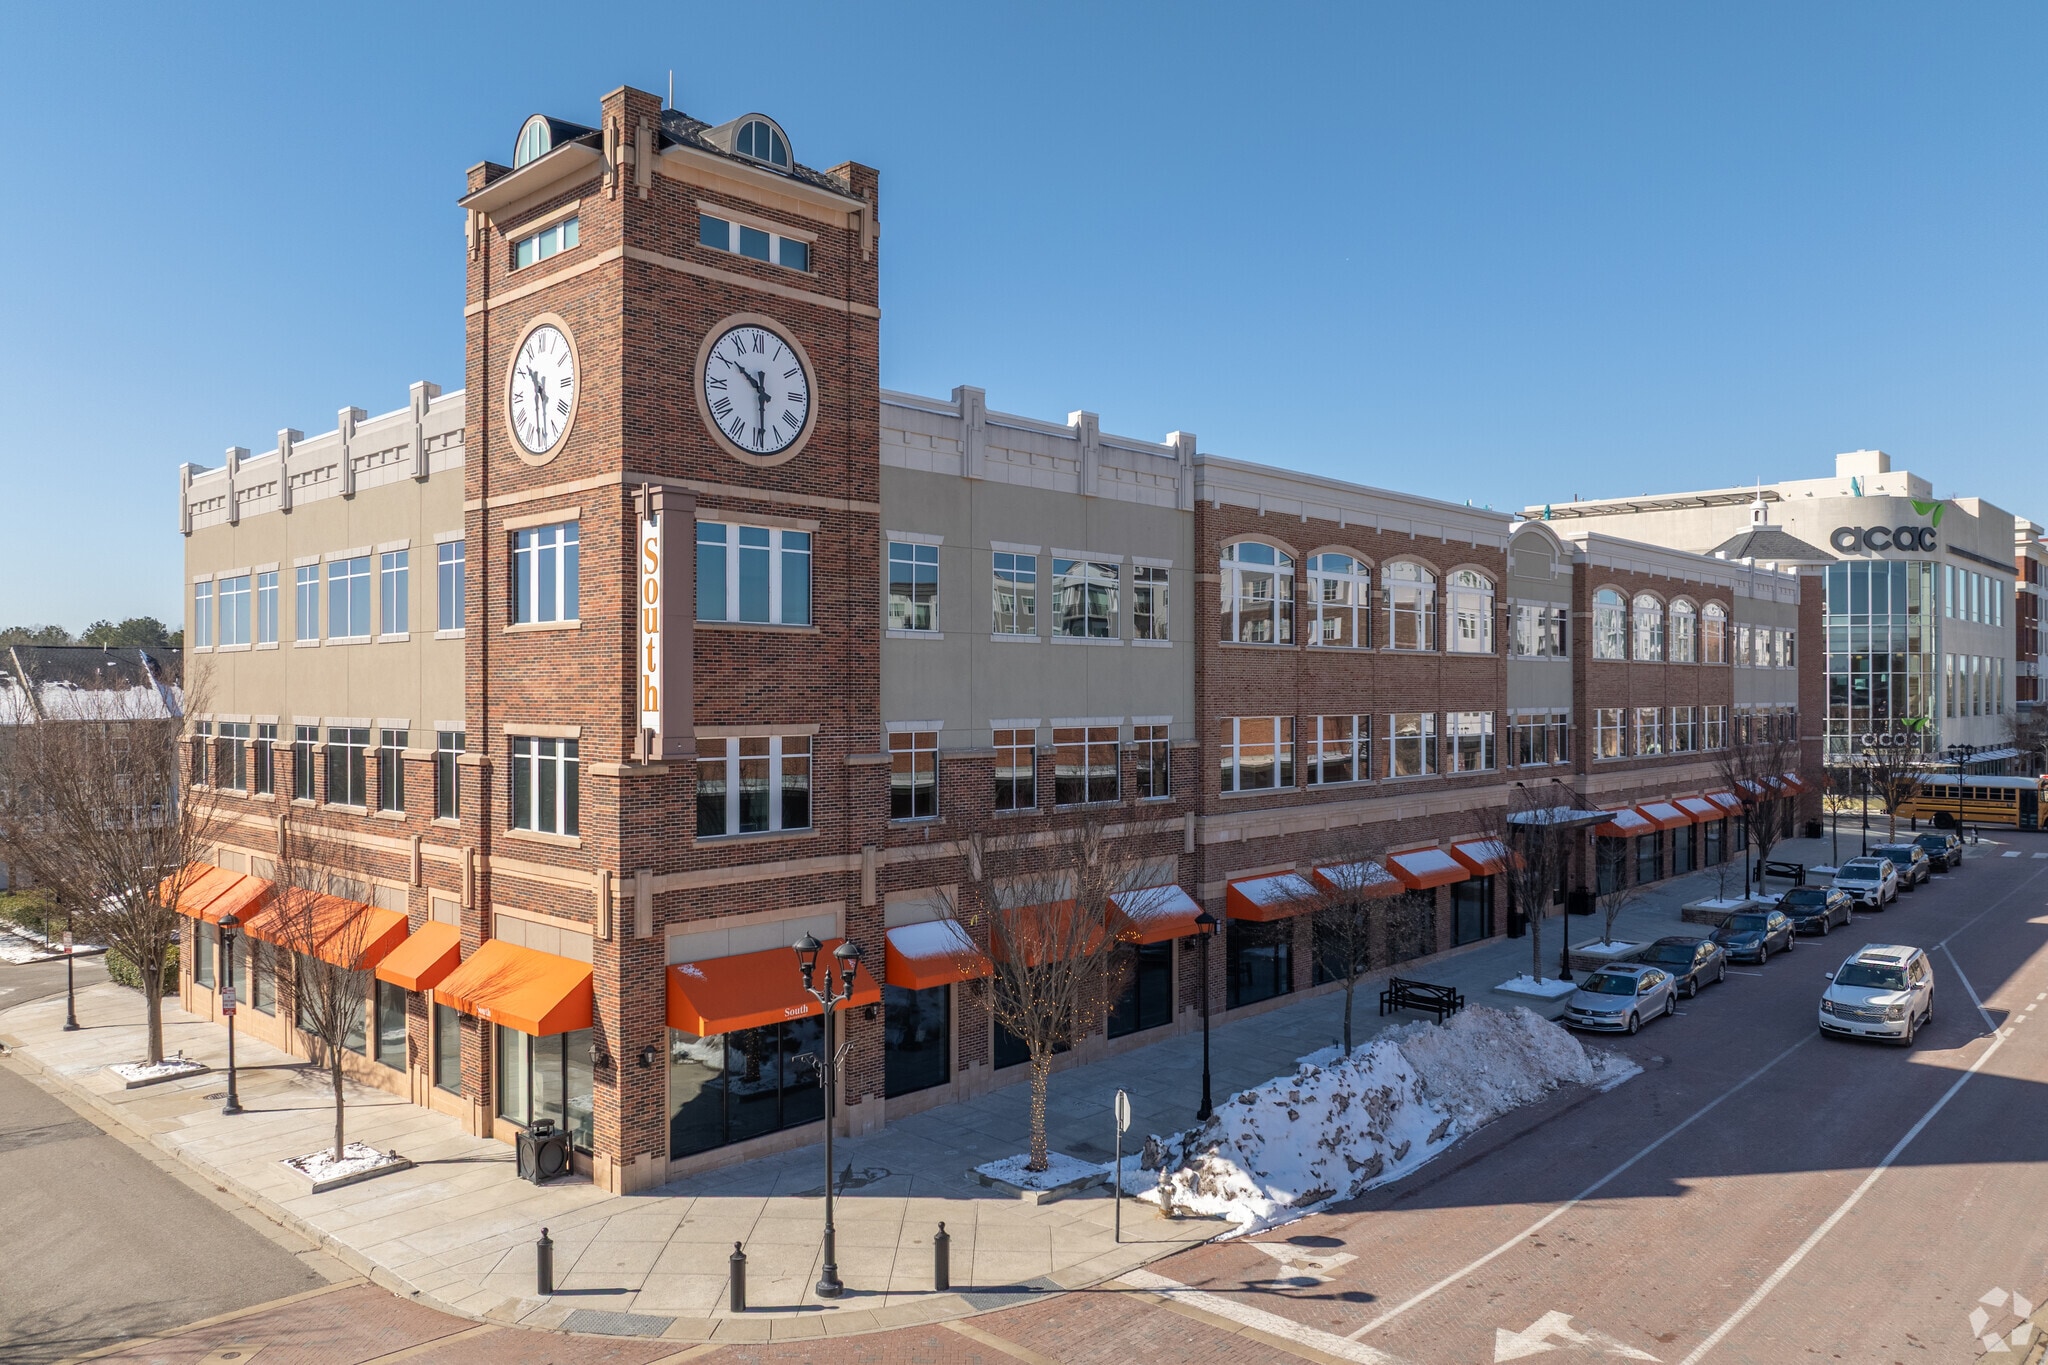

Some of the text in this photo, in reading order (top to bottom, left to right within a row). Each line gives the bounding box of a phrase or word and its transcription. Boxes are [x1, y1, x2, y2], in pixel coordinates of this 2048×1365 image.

[1830, 526, 1937, 552] acac
[643, 537, 659, 712] South
[785, 1004, 808, 1016] South
